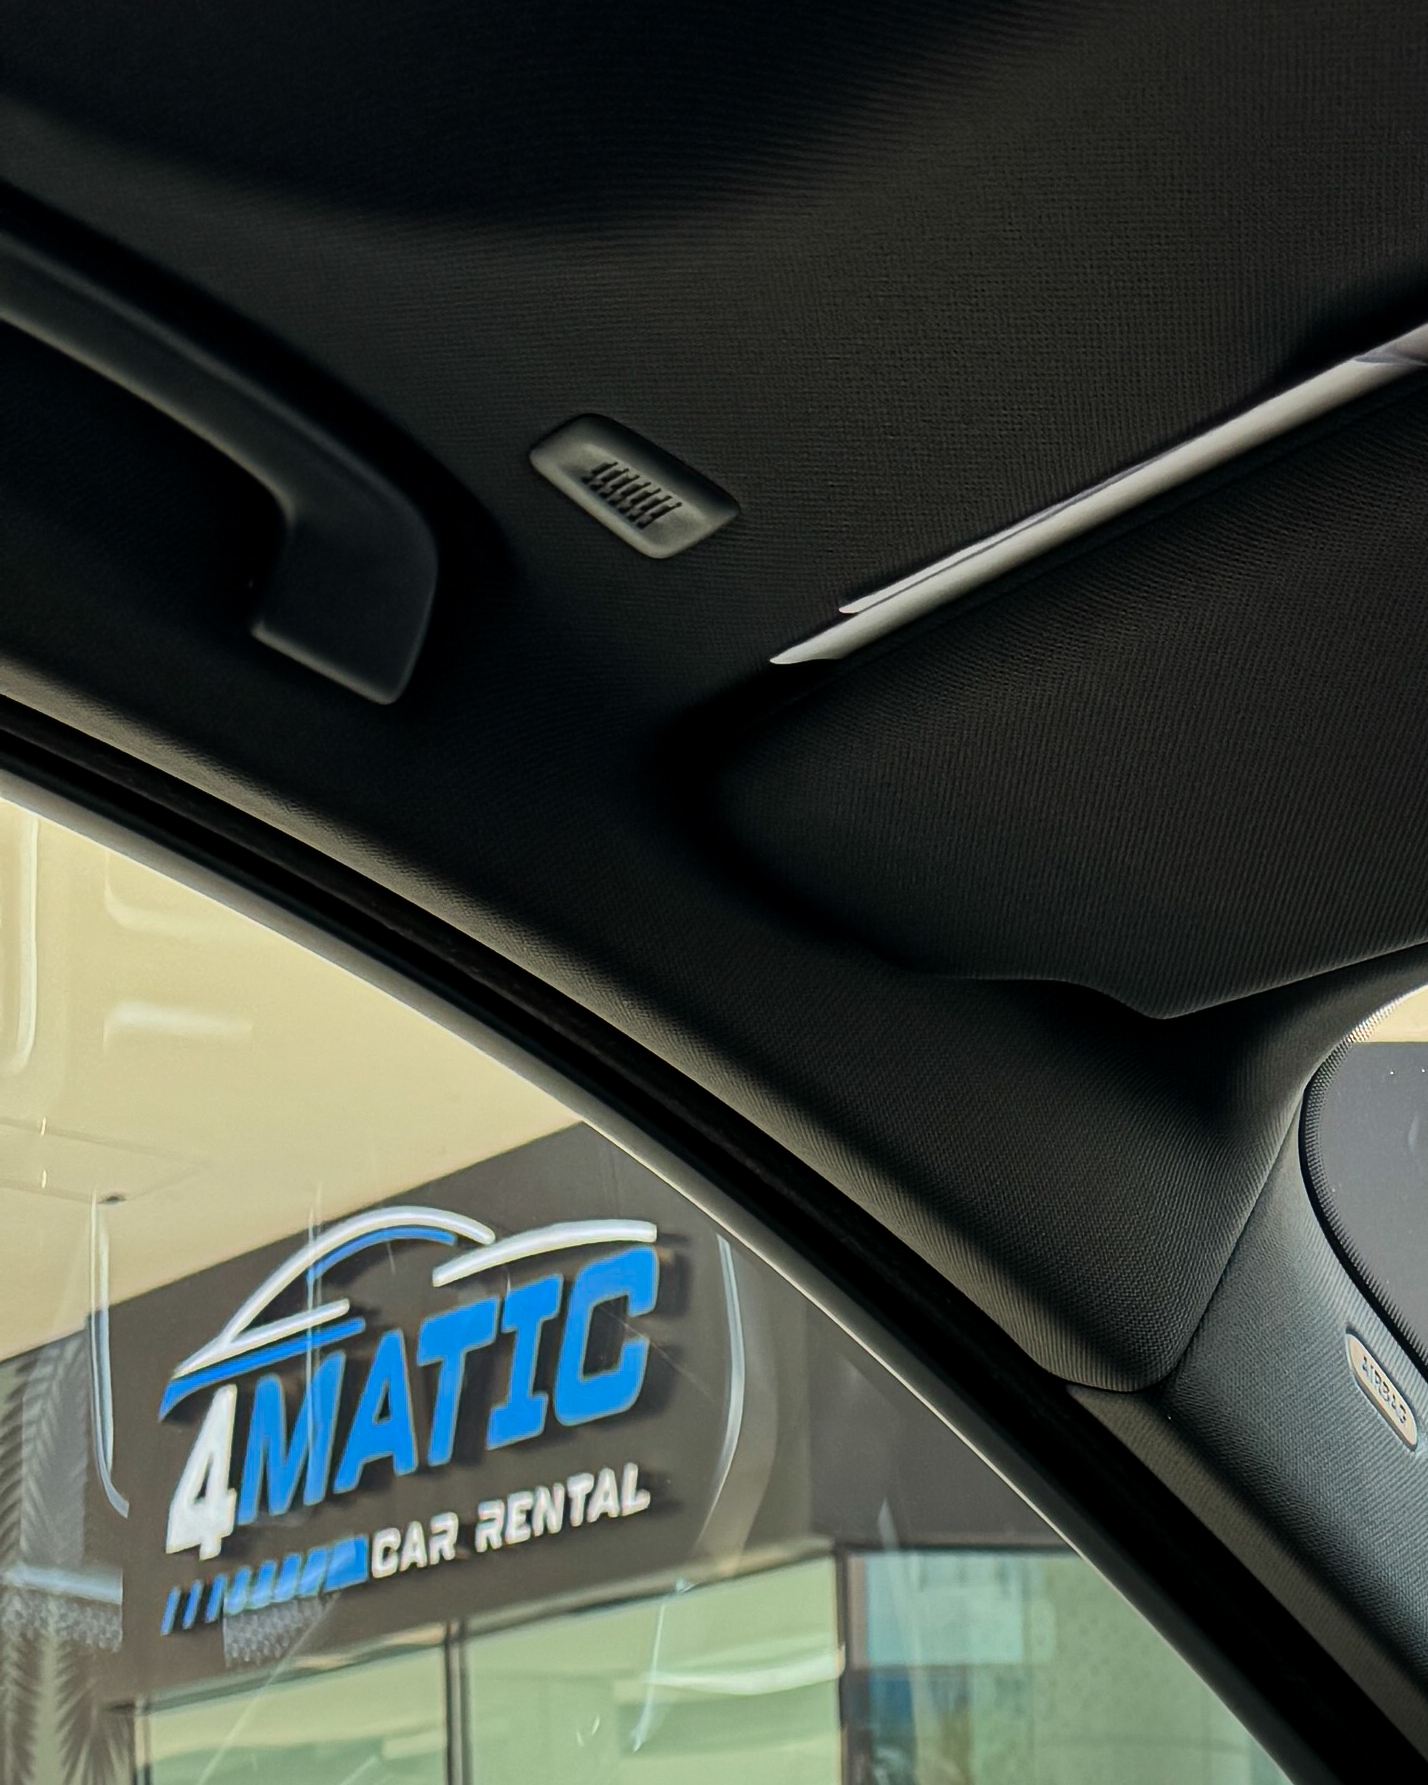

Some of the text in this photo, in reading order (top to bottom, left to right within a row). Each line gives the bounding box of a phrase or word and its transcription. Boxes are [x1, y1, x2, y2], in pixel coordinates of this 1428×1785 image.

[165, 1245, 658, 1561] 4MATIC
[370, 1463, 651, 1580] CAR RENTAL
